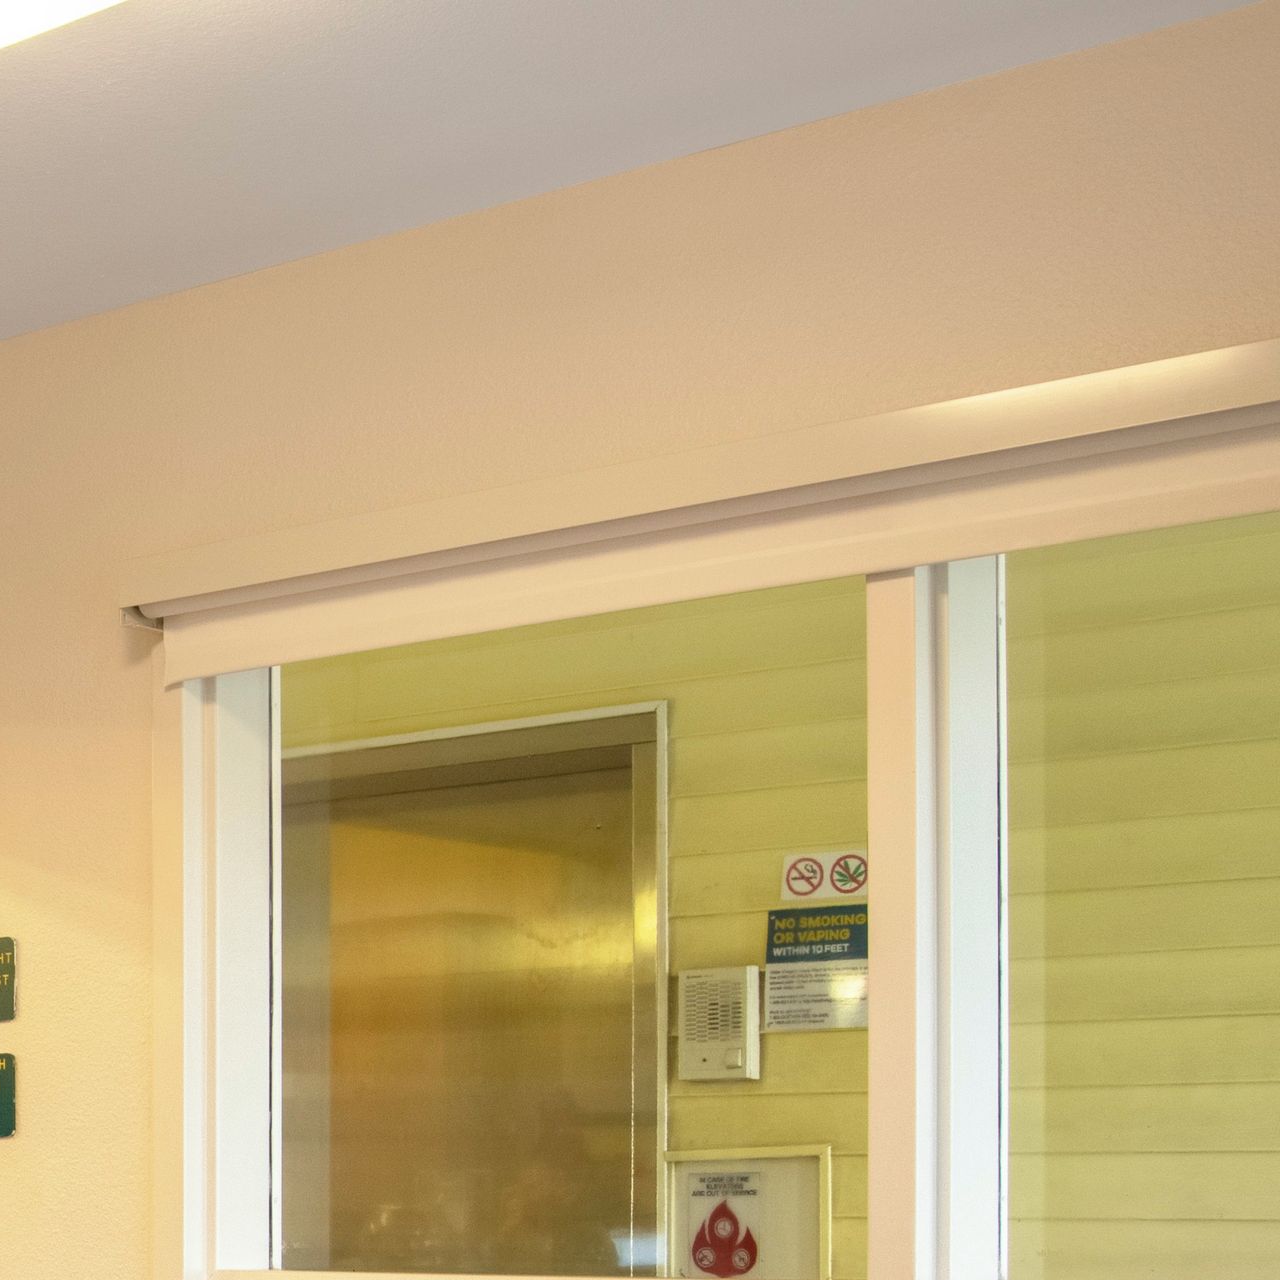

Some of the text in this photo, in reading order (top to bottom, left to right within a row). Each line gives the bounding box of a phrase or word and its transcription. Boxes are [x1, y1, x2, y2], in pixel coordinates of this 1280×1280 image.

[775, 914, 866, 930] NO SMOKING
[773, 928, 850, 944] OR VAPING
[773, 943, 850, 957] WITHIN 10 FEET
